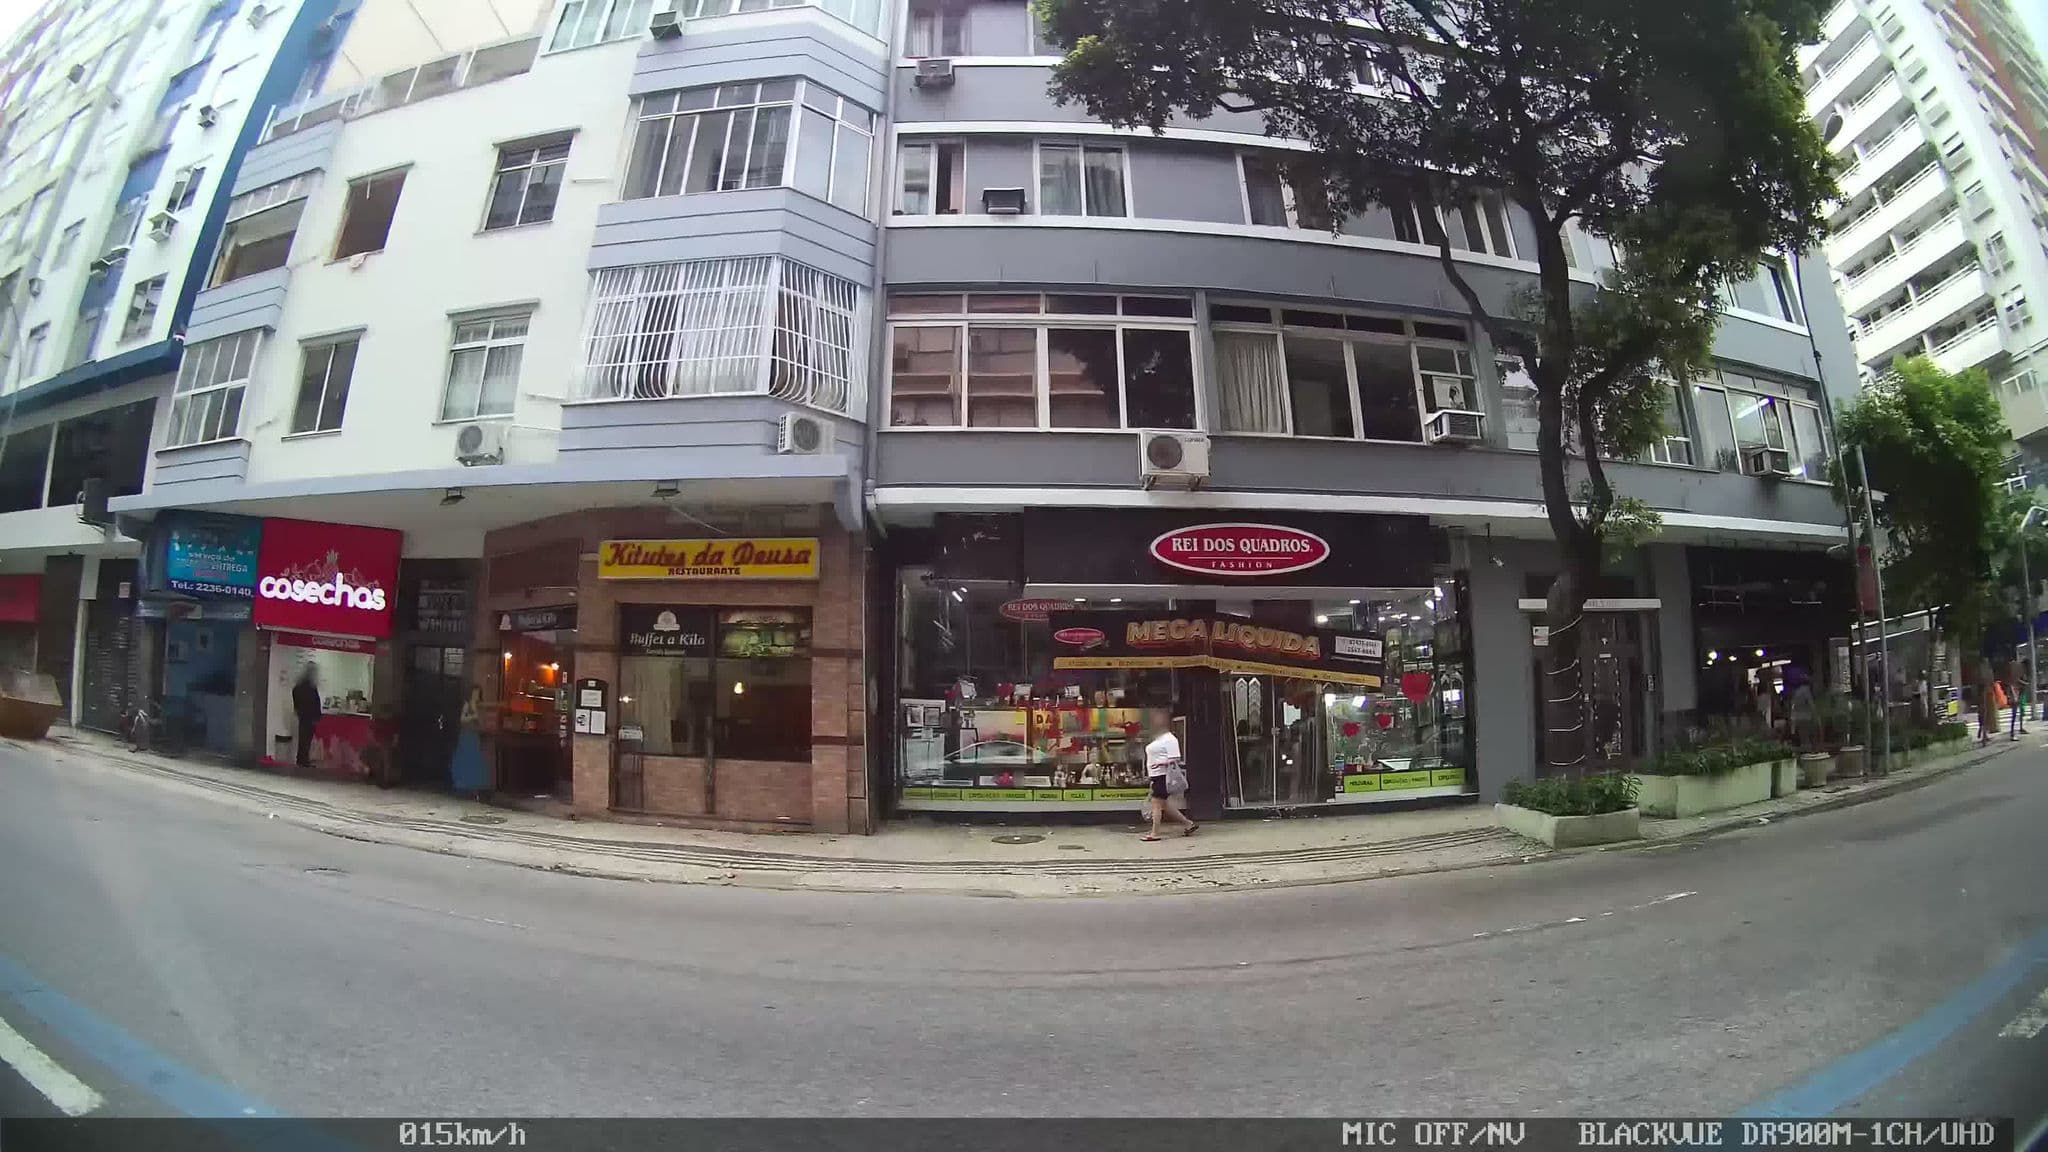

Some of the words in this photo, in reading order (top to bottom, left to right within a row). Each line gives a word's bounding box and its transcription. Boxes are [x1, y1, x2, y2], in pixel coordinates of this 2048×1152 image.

[1172, 537, 1198, 551] REI
[1203, 538, 1235, 552] DOS
[604, 543, 687, 567] Kitutes
[691, 543, 725, 566] da
[733, 541, 812, 566] Deusa
[667, 567, 741, 576] RESTAURANTE
[1211, 560, 1273, 569] FASHION
[260, 572, 386, 610] cosechas
[629, 632, 664, 647] Buffet
[667, 636, 675, 645] a
[679, 632, 706, 646] Kilo
[1127, 619, 1207, 645] MEGA
[1212, 621, 1320, 658] LIQUIDA
